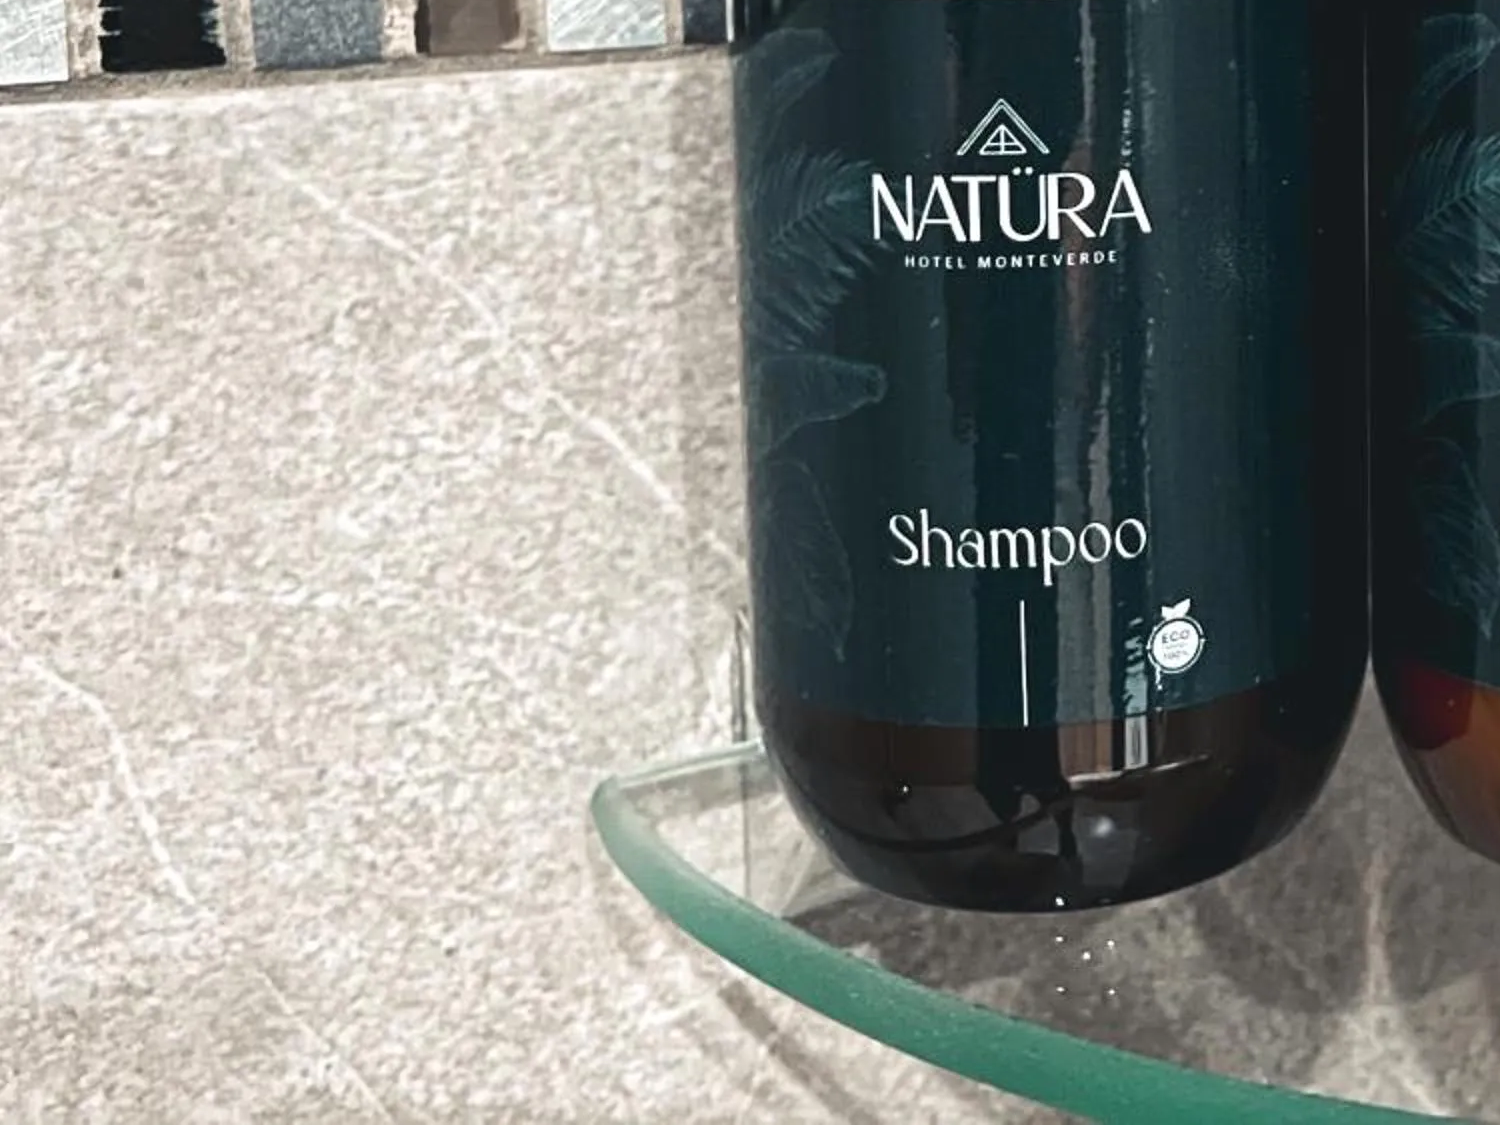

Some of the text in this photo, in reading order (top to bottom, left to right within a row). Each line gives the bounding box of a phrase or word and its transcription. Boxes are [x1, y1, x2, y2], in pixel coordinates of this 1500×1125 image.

[872, 166, 1152, 242] NATÜRA
[905, 250, 1118, 269] HOTEL MONTEVERDE
[888, 508, 1147, 586] Shampoo
[1162, 630, 1189, 644] ECO
